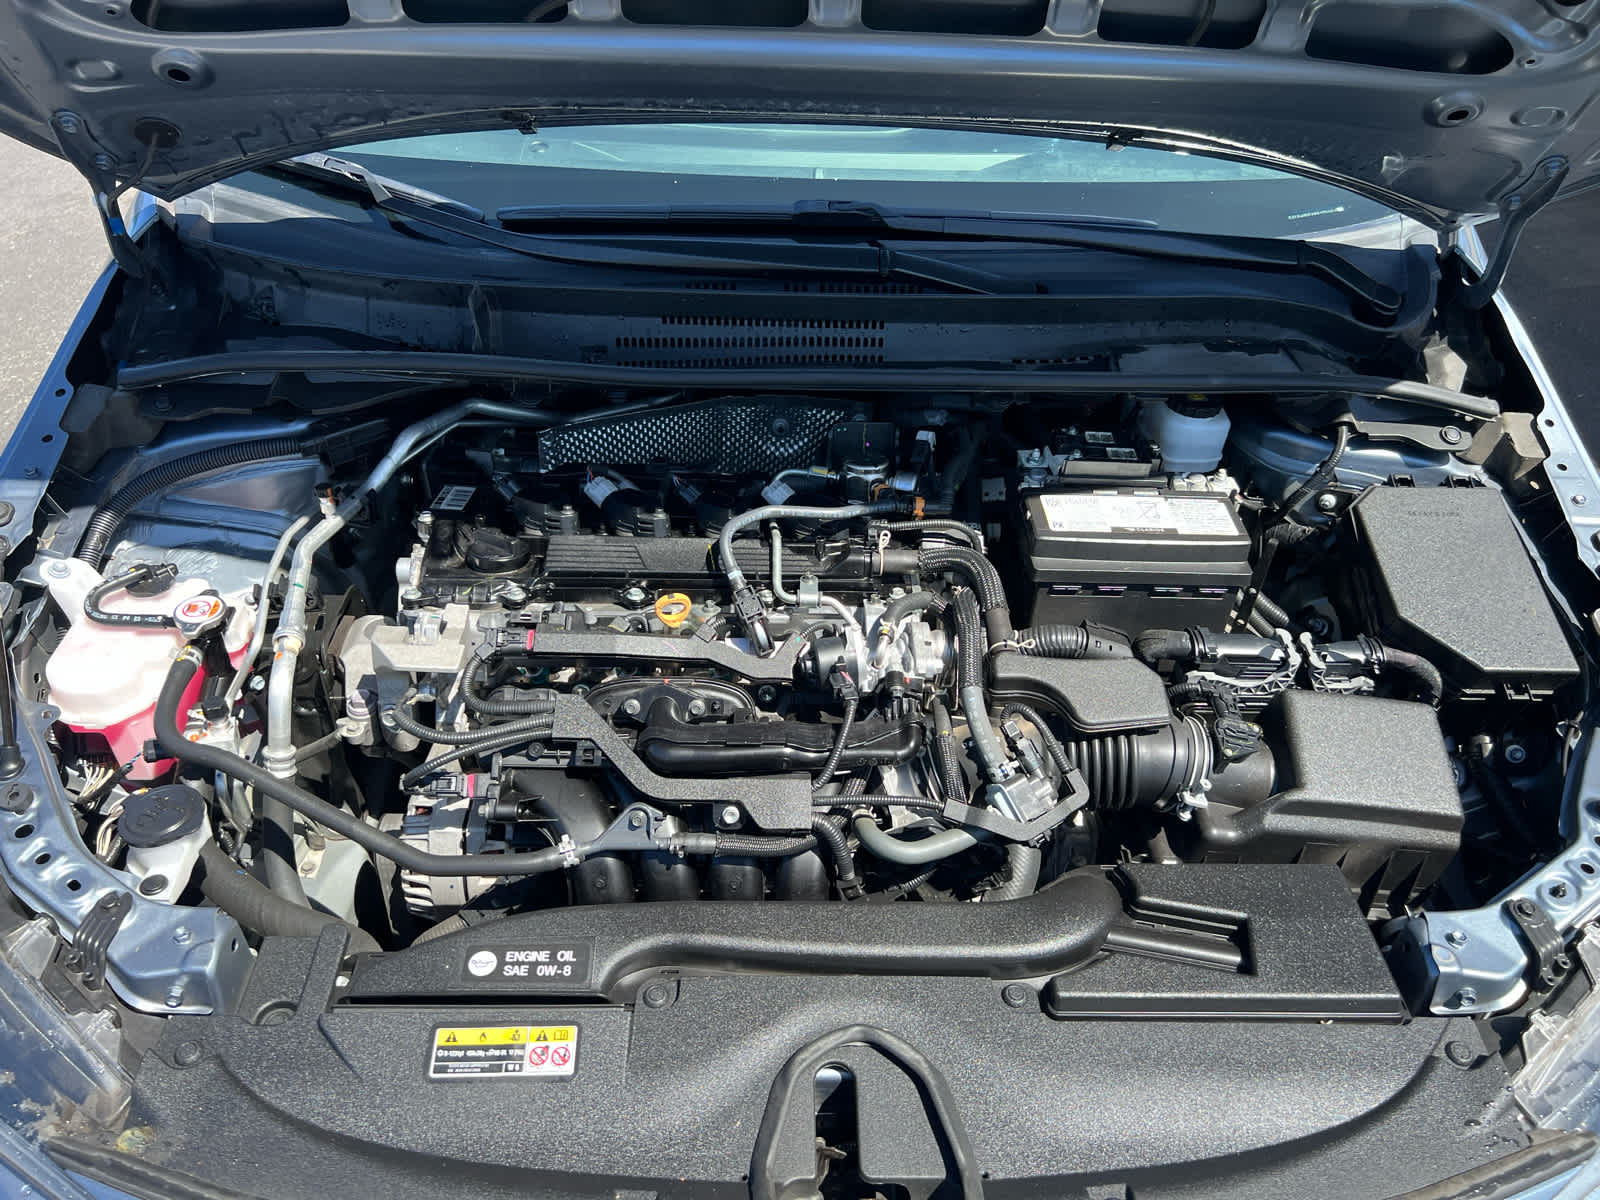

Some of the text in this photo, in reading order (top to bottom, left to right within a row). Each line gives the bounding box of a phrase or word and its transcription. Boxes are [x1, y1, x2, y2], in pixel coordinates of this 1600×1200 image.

[505, 950, 577, 962] ENGINE OIL
[502, 965, 529, 976] SAE
[536, 965, 572, 977] 0W-8
